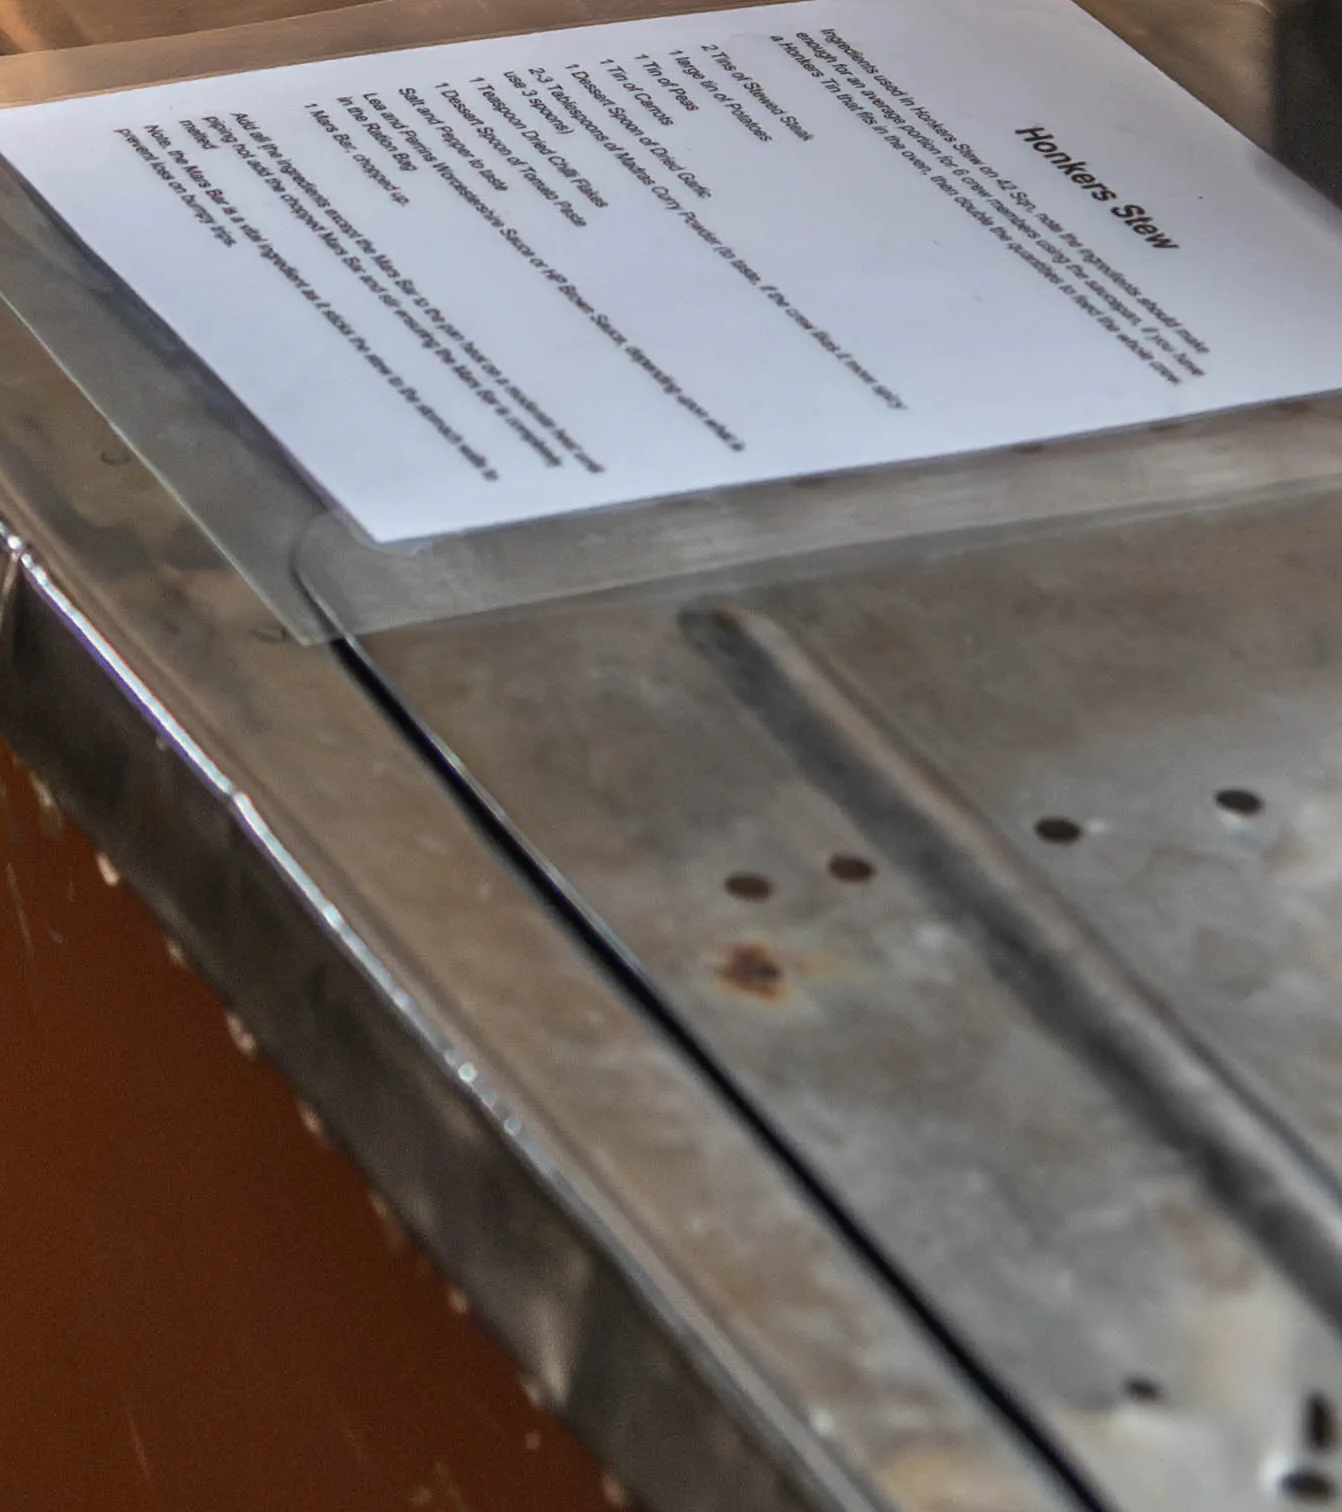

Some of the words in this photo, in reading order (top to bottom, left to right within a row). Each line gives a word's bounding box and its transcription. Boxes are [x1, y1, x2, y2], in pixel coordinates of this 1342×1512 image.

[502, 70, 527, 89] use
[527, 67, 555, 84] 2-3
[642, 60, 663, 77] Tin
[656, 77, 680, 88] of
[668, 87, 700, 112] Peas
[674, 56, 706, 80] large
[698, 79, 719, 93] tin
[520, 89, 538, 98] 3
[606, 65, 629, 82] Tin
[621, 82, 645, 93] of
[633, 92, 674, 126] Carrots
[700, 44, 720, 52] 2
[710, 51, 737, 72] Tins
[730, 71, 753, 82] of
[742, 81, 788, 116] Stewed
[779, 115, 814, 142] Steak
[712, 92, 735, 103] of
[819, 28, 879, 75] Ingredients
[872, 74, 909, 97] used
[898, 96, 916, 107] in
[909, 106, 957, 144] Honkers
[952, 143, 985, 166] Stew
[229, 112, 260, 132] Add
[528, 98, 575, 135] spoons)
[546, 83, 610, 143] Tablespoons
[723, 102, 773, 143] Potatoes
[769, 35, 784, 43] a
[778, 41, 825, 78] Honkers
[820, 77, 842, 94] Tin
[835, 93, 865, 112] that
[855, 111, 878, 126] fits
[871, 124, 889, 135] in
[883, 134, 907, 151] the
[930, 175, 959, 197] then
[795, 31, 838, 64] enough
[830, 63, 854, 76] for
[845, 76, 866, 89] an
[859, 89, 906, 125] average
[896, 124, 942, 156] portion
[935, 155, 959, 168] for
[960, 176, 994, 198] crew
[178, 119, 219, 150] melted
[248, 131, 272, 144] all
[257, 143, 284, 159] the
[309, 109, 339, 134] Mars
[351, 153, 401, 192] chopped
[336, 96, 354, 107] in
[346, 106, 369, 123] the
[360, 122, 398, 153] Ration
[391, 152, 418, 172] Bag
[398, 87, 426, 107] Salt
[415, 107, 445, 126] and
[435, 125, 476, 158] Pepper
[467, 158, 485, 170] to
[478, 169, 509, 192] taste
[477, 84, 527, 130] Teaspoon
[520, 129, 557, 156] Dried
[546, 155, 580, 179] Chilli
[569, 178, 609, 209] Flakes
[570, 70, 616, 107] Dessert
[607, 106, 644, 137] Spoon
[638, 136, 660, 147] of
[649, 146, 686, 172] Dried
[676, 172, 712, 199] Garlic
[602, 141, 625, 152] of
[166, 149, 189, 165] the
[200, 115, 239, 144] piping
[231, 143, 257, 160] hot
[246, 159, 275, 178] add
[263, 177, 286, 193] the
[279, 193, 328, 233] chopped
[362, 92, 388, 112] Lea
[379, 111, 410, 130] and
[397, 129, 438, 163] Perrins
[431, 161, 505, 228] Worcestershire
[498, 228, 536, 258] Sauce
[440, 89, 485, 127] Dessert
[475, 126, 513, 157] Spoon
[506, 156, 529, 167] of
[518, 165, 559, 201] Tomato
[553, 200, 587, 228] Paste
[613, 151, 656, 186] Madras
[113, 128, 160, 162] prevent
[149, 161, 176, 181] loss
[167, 181, 188, 195] on
[180, 193, 217, 225] bumpy
[181, 165, 212, 189] Mars
[275, 159, 331, 209] ingredients
[1014, 126, 1117, 202] Honkers
[1110, 204, 1179, 249] Stew
[204, 188, 230, 206] Bar
[221, 206, 238, 216] is
[650, 185, 684, 211] Curry
[229, 216, 246, 224] a
[238, 223, 268, 243] vital
[323, 208, 363, 240] except
[677, 210, 723, 246] Powder
